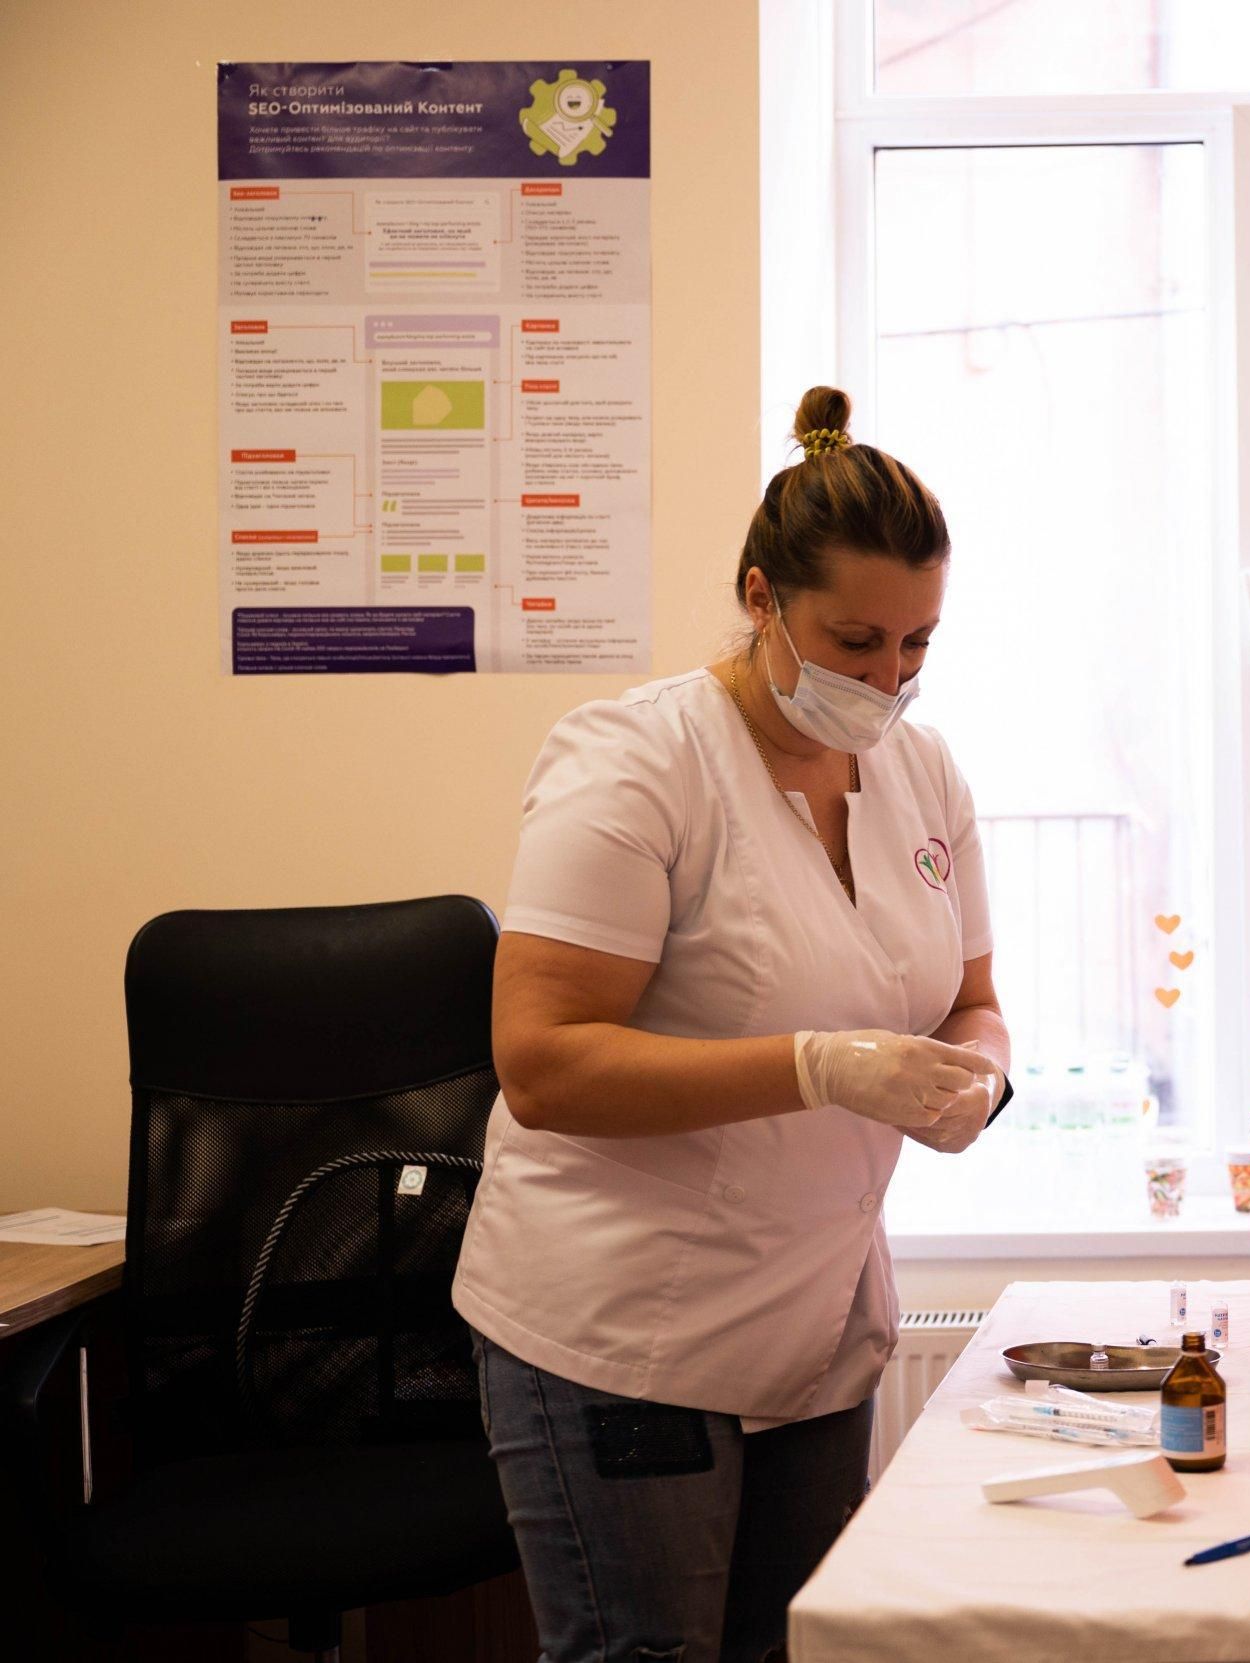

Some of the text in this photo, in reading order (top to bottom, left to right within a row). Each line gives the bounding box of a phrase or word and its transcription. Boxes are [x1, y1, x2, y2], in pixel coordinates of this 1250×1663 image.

[249, 84, 345, 98] Як створити
[248, 101, 483, 116] SEO-Оптимізований Контент
